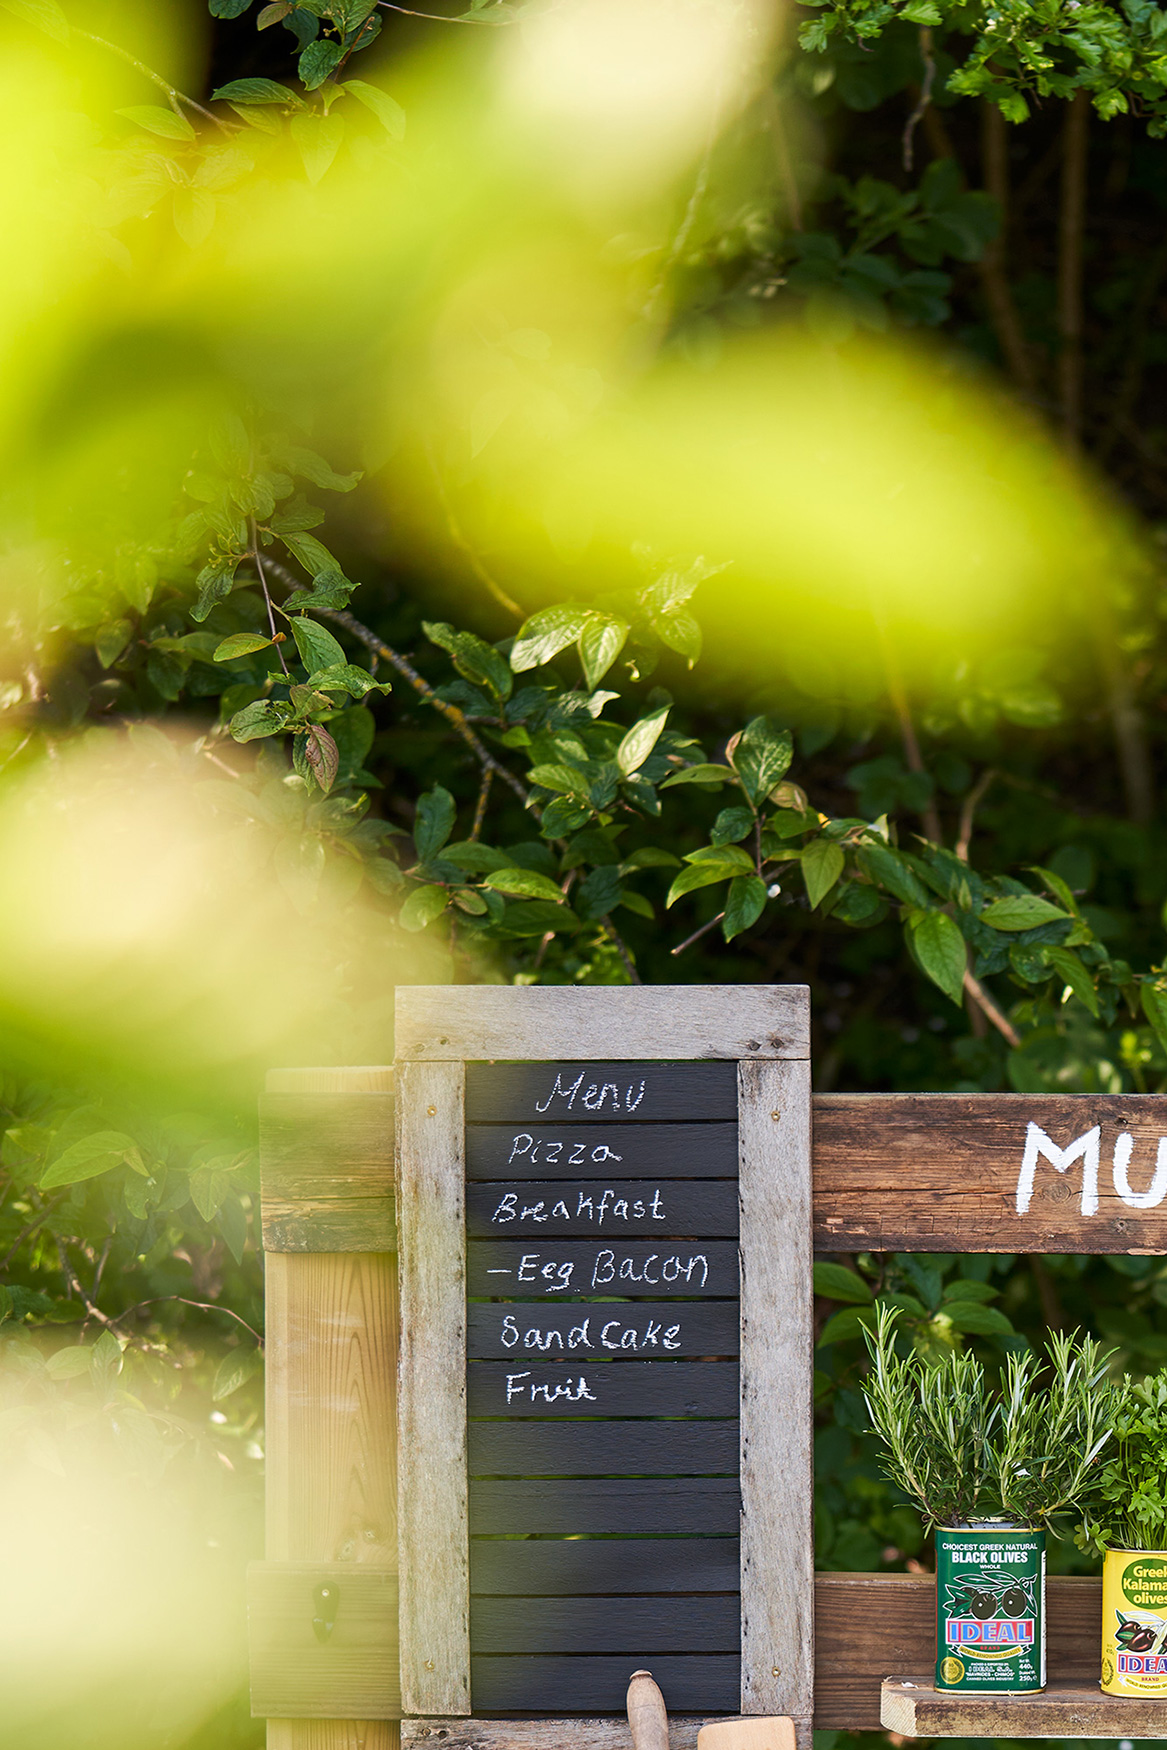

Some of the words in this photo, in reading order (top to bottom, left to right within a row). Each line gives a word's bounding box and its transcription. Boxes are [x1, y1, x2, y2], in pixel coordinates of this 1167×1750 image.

[535, 1070, 646, 1113] Menu
[508, 1132, 623, 1165] Pizza
[491, 1189, 666, 1226] Breakfast
[591, 1249, 709, 1289] Bacon
[506, 1371, 597, 1405] Fruit
[942, 1543, 978, 1551] CHOICEST
[979, 1543, 1004, 1551] GREEK
[951, 1551, 988, 1563] BLACK
[990, 1551, 1028, 1563] OLIVES
[949, 1622, 1031, 1642] IDEAL
